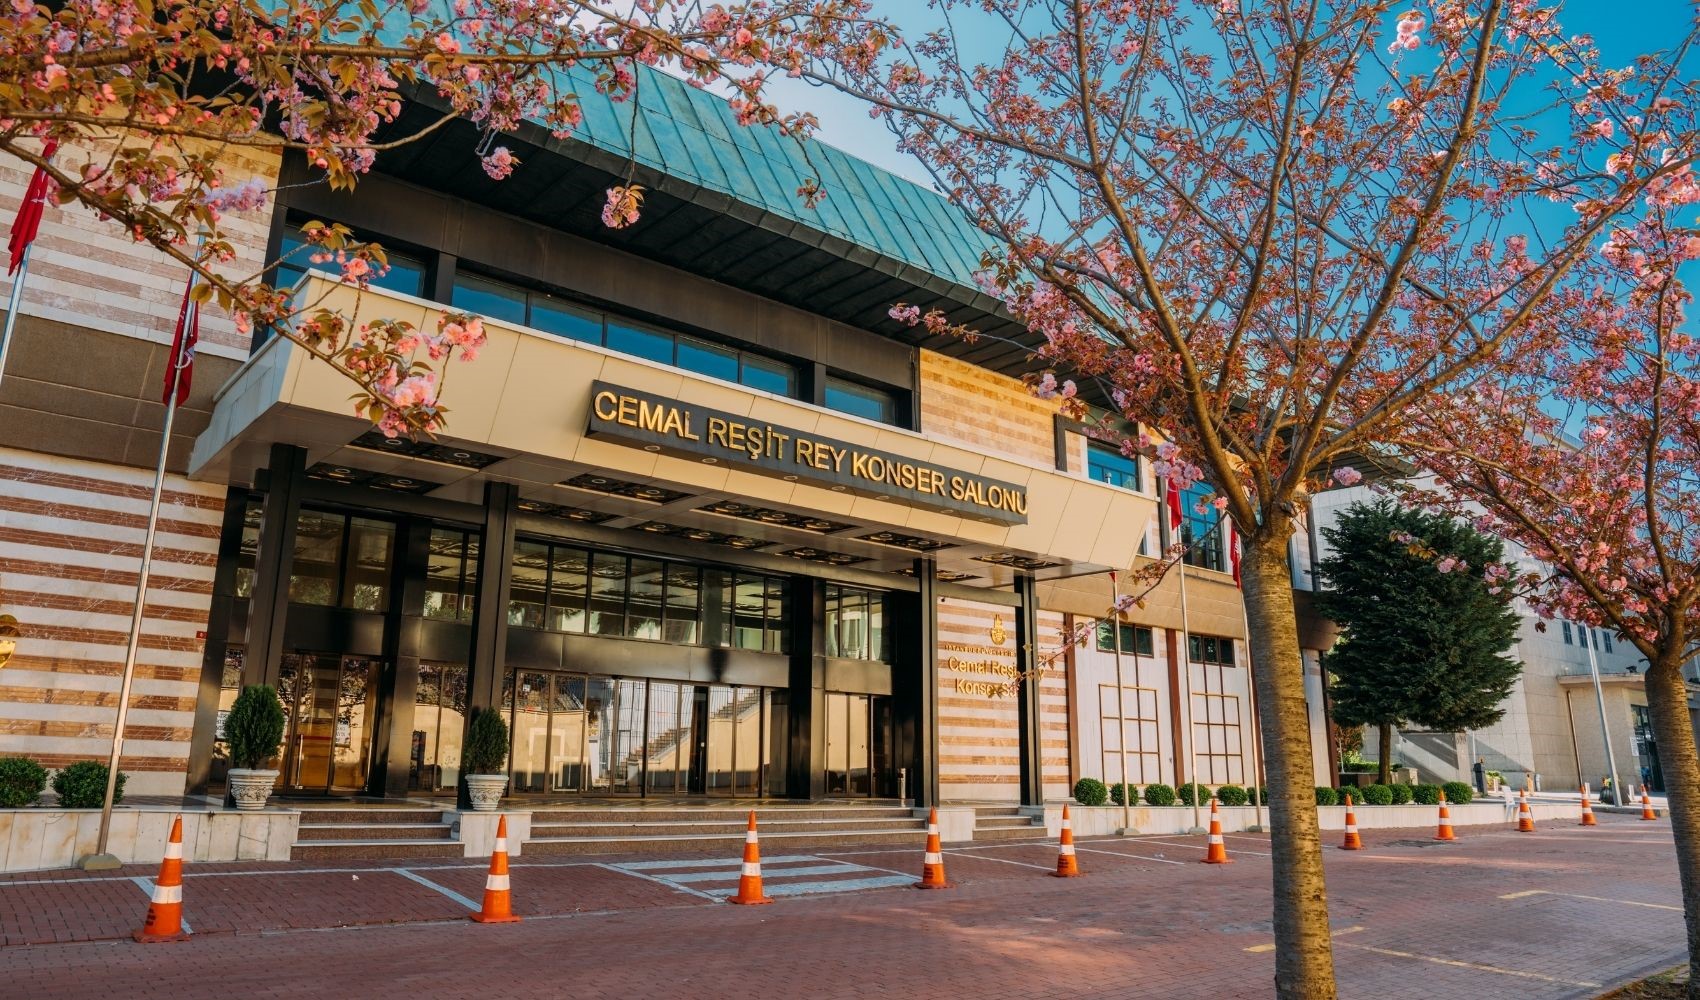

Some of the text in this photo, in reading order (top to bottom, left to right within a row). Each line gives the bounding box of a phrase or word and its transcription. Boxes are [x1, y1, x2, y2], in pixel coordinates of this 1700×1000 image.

[593, 390, 1028, 515] CEMAL REŞİT REY KONSER SALONU
[948, 655, 1017, 679] Cemal Reşi
[955, 677, 998, 697] Konse
